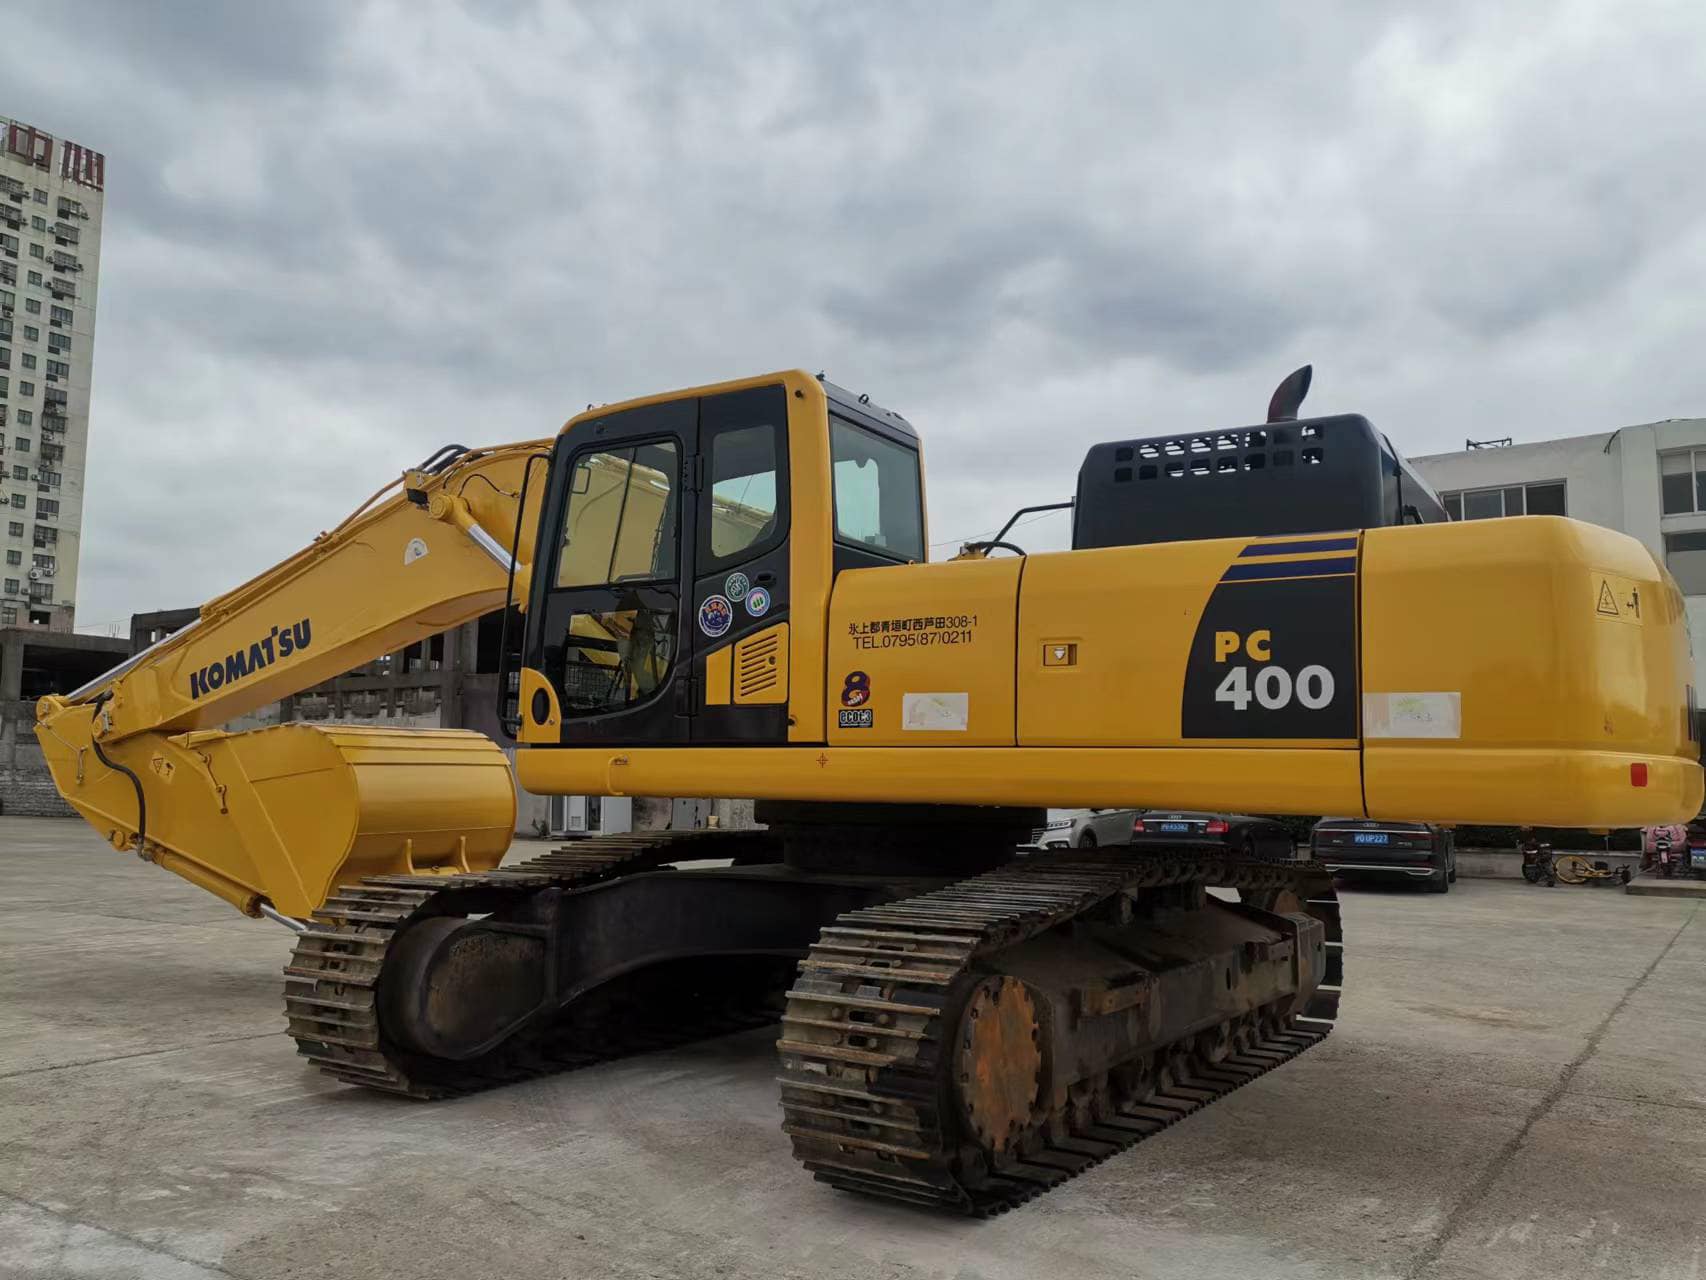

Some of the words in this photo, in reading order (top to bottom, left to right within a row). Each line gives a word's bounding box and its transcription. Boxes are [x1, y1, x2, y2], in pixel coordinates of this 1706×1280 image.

[190, 618, 311, 700] KOMATSU
[853, 630, 972, 649] TEL.0795(87)0211
[1215, 629, 1271, 662] PC
[1215, 664, 1335, 710] 400
